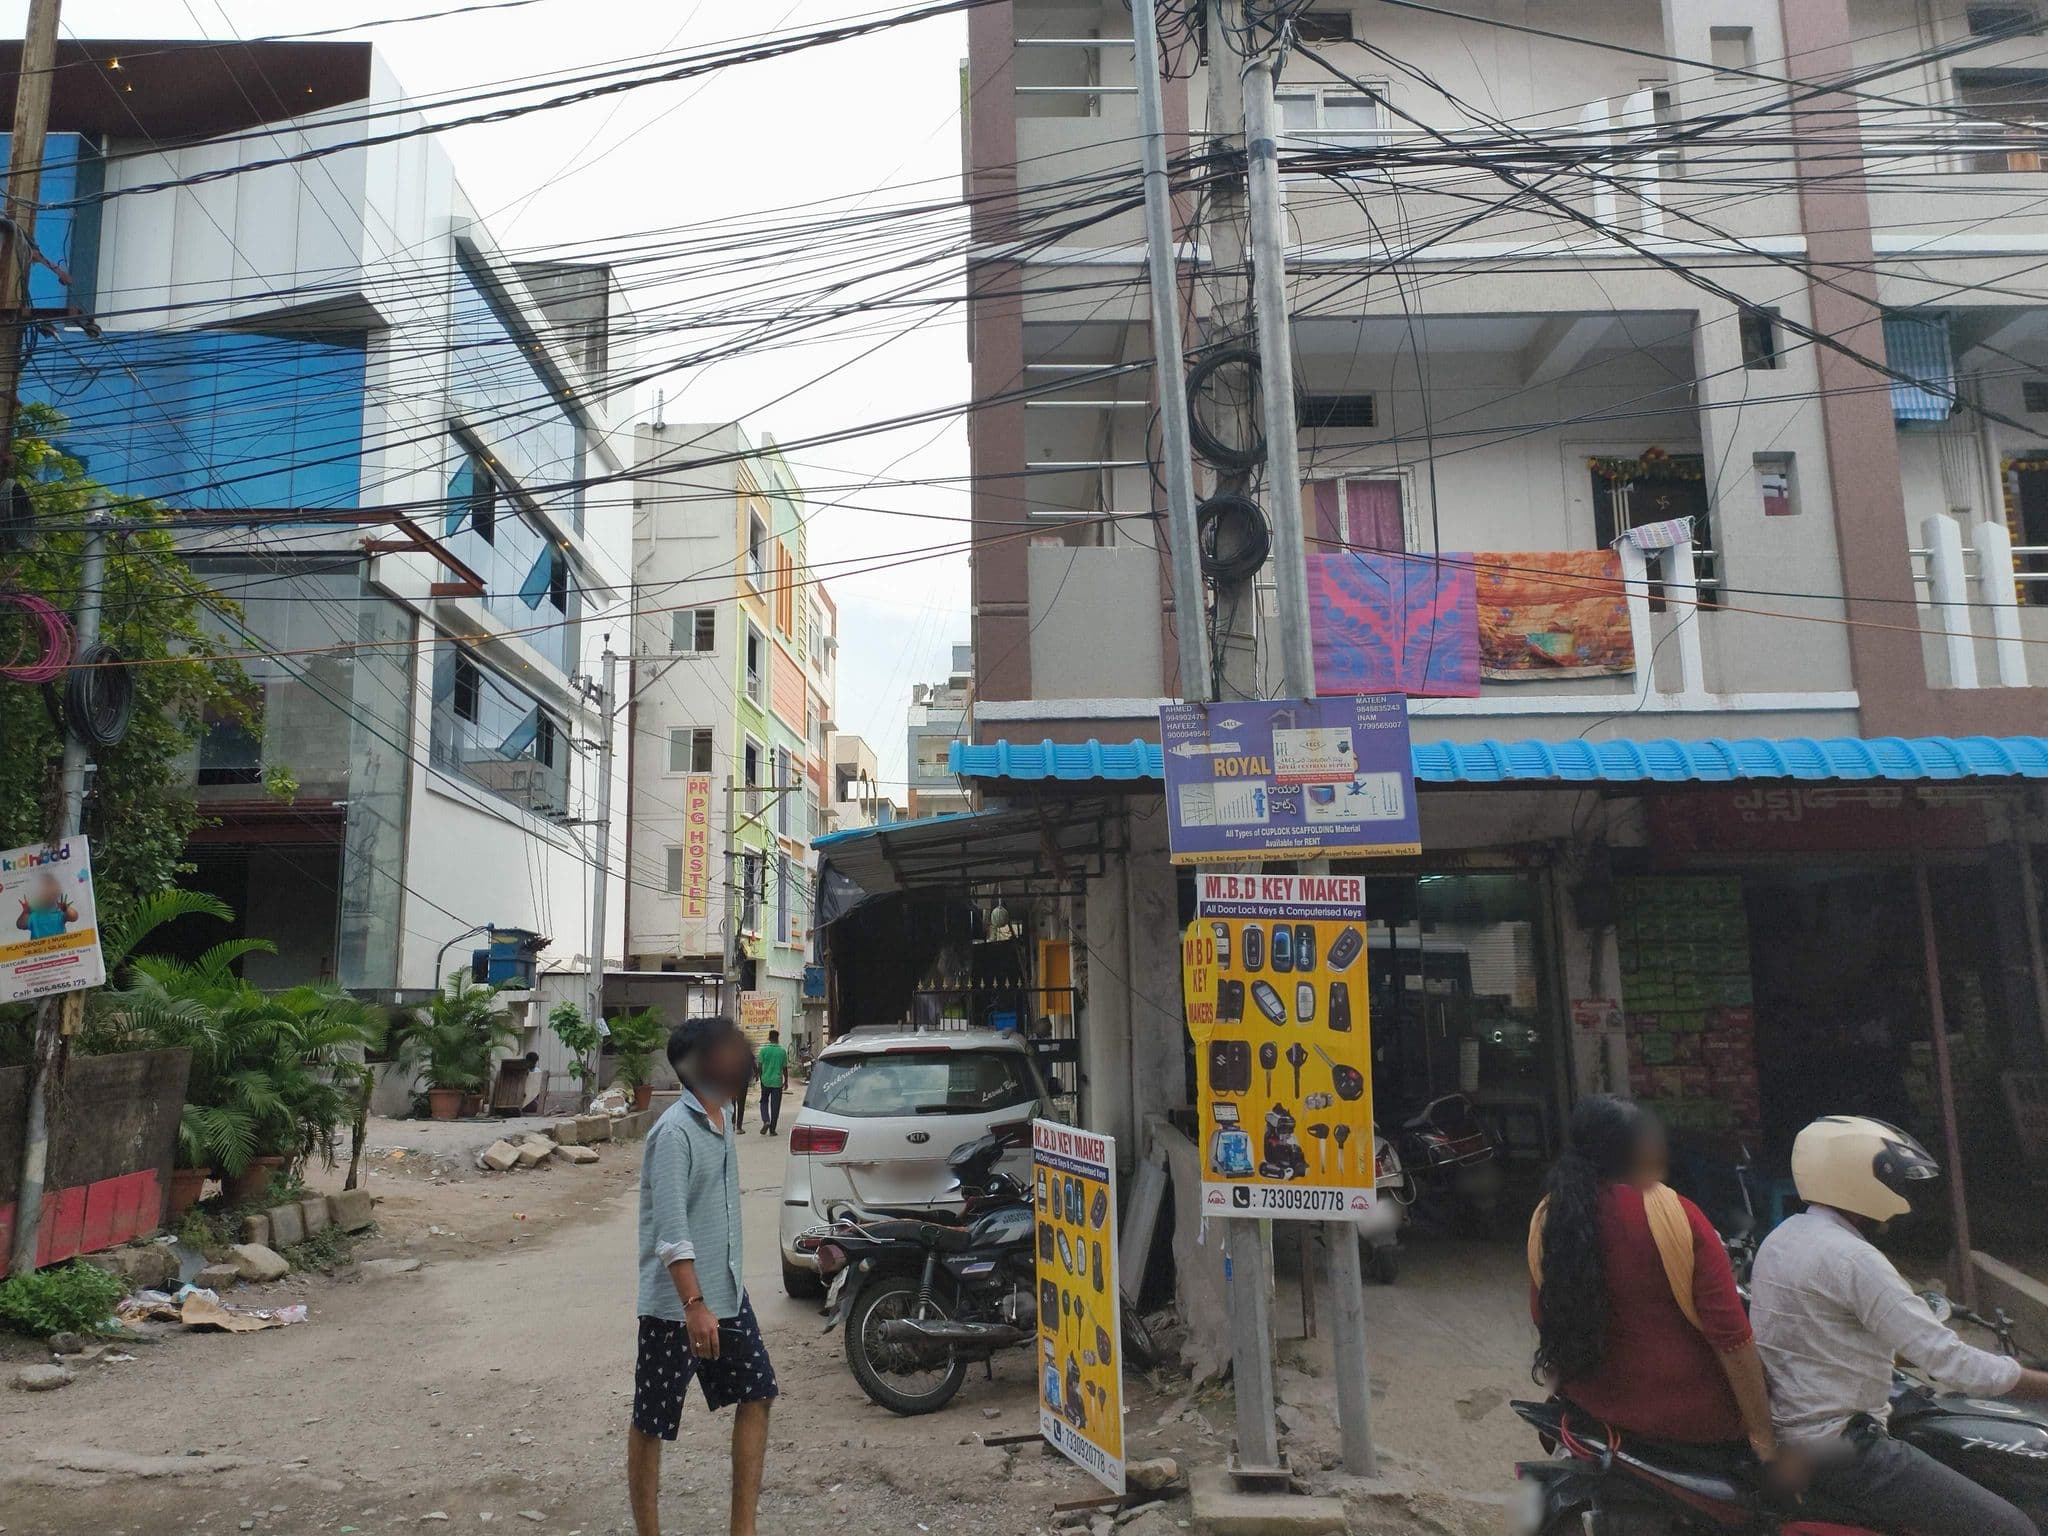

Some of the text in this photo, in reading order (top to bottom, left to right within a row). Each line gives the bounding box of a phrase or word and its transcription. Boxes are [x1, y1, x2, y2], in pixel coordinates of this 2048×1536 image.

[1165, 705, 1193, 713] AHMED
[1355, 696, 1387, 704] MATEEN
[1213, 756, 1272, 777] ROYAL
[689, 781, 708, 795] PR
[1225, 824, 1361, 839] All Types of CUPLOCK SCAFFOLDING Material
[1265, 837, 1321, 847] Available for RENT
[688, 798, 705, 915] PG HOSTEL
[1205, 875, 1361, 902] M.B.D KEY MAKER
[1206, 904, 1362, 919] All Door Lock Keys & Computerised Keys
[1193, 967, 1208, 993] KEY
[1188, 1002, 1214, 1024] MAKERS
[910, 1132, 926, 1143] KIA
[1034, 1125, 1105, 1164] M.B.D KEY MAKER
[1261, 1188, 1344, 1211] 7330920778
